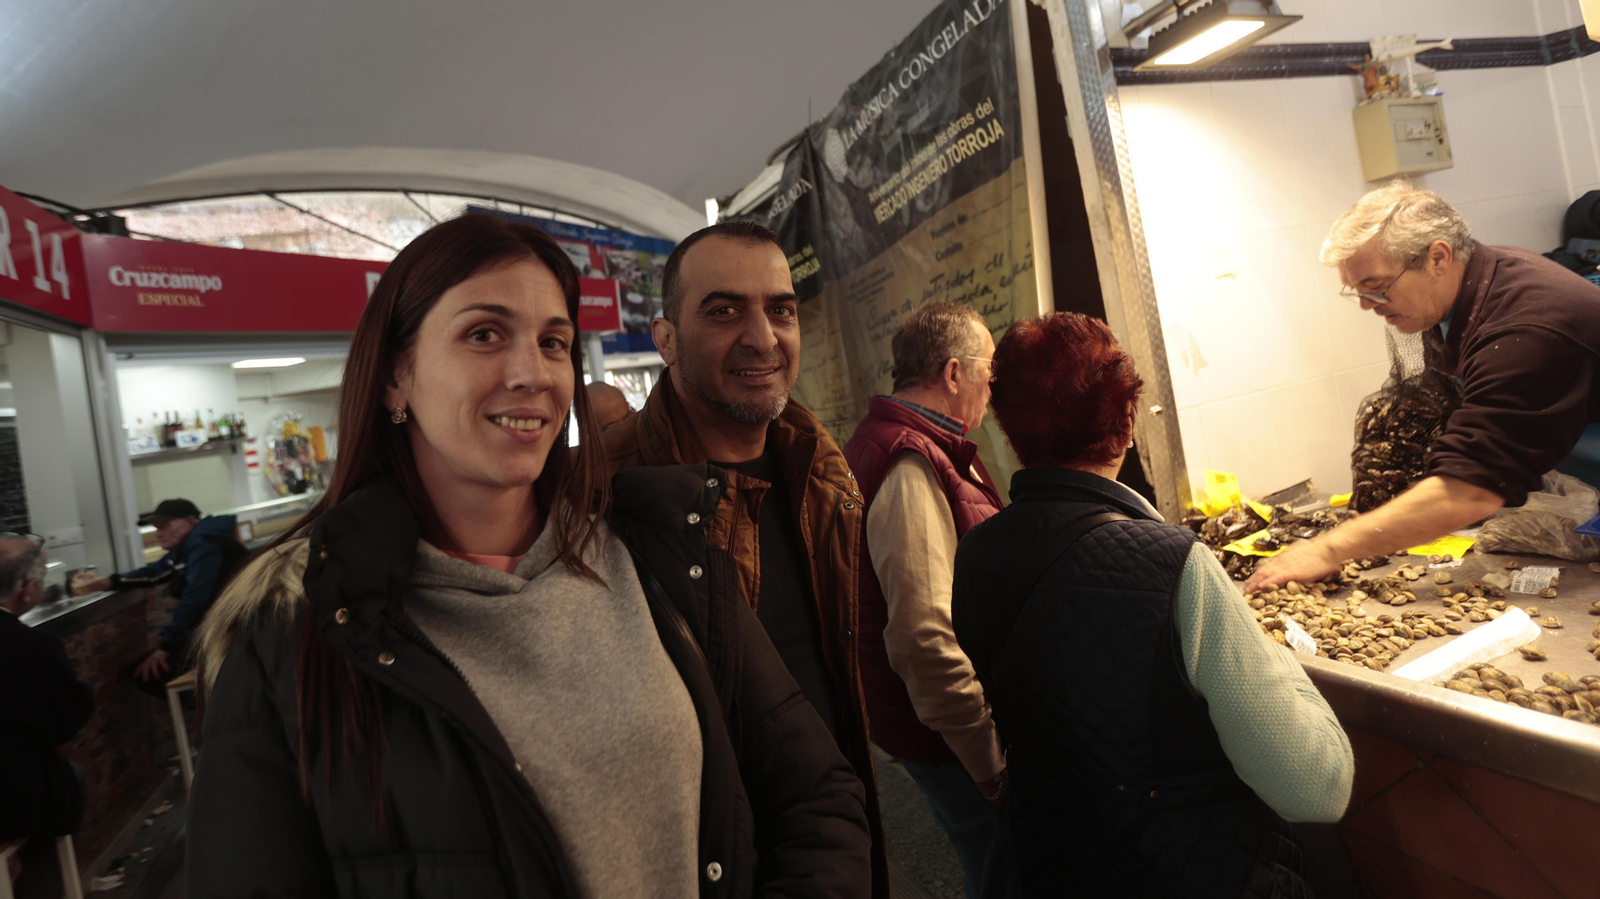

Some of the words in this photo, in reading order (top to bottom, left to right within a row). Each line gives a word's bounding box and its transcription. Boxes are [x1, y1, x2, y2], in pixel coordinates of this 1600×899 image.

[935, 132, 948, 148] las
[947, 112, 975, 139] obras
[975, 96, 994, 119] del
[842, 127, 857, 150] LA
[873, 187, 908, 225] MERCADO
[907, 154, 948, 200] INGENIERO
[945, 118, 1004, 167] TORROJA
[24, 217, 71, 300] 14
[108, 265, 222, 294] Cruzcampo
[137, 292, 205, 307] ESPECIAL
[580, 295, 613, 309] ruzcampo
